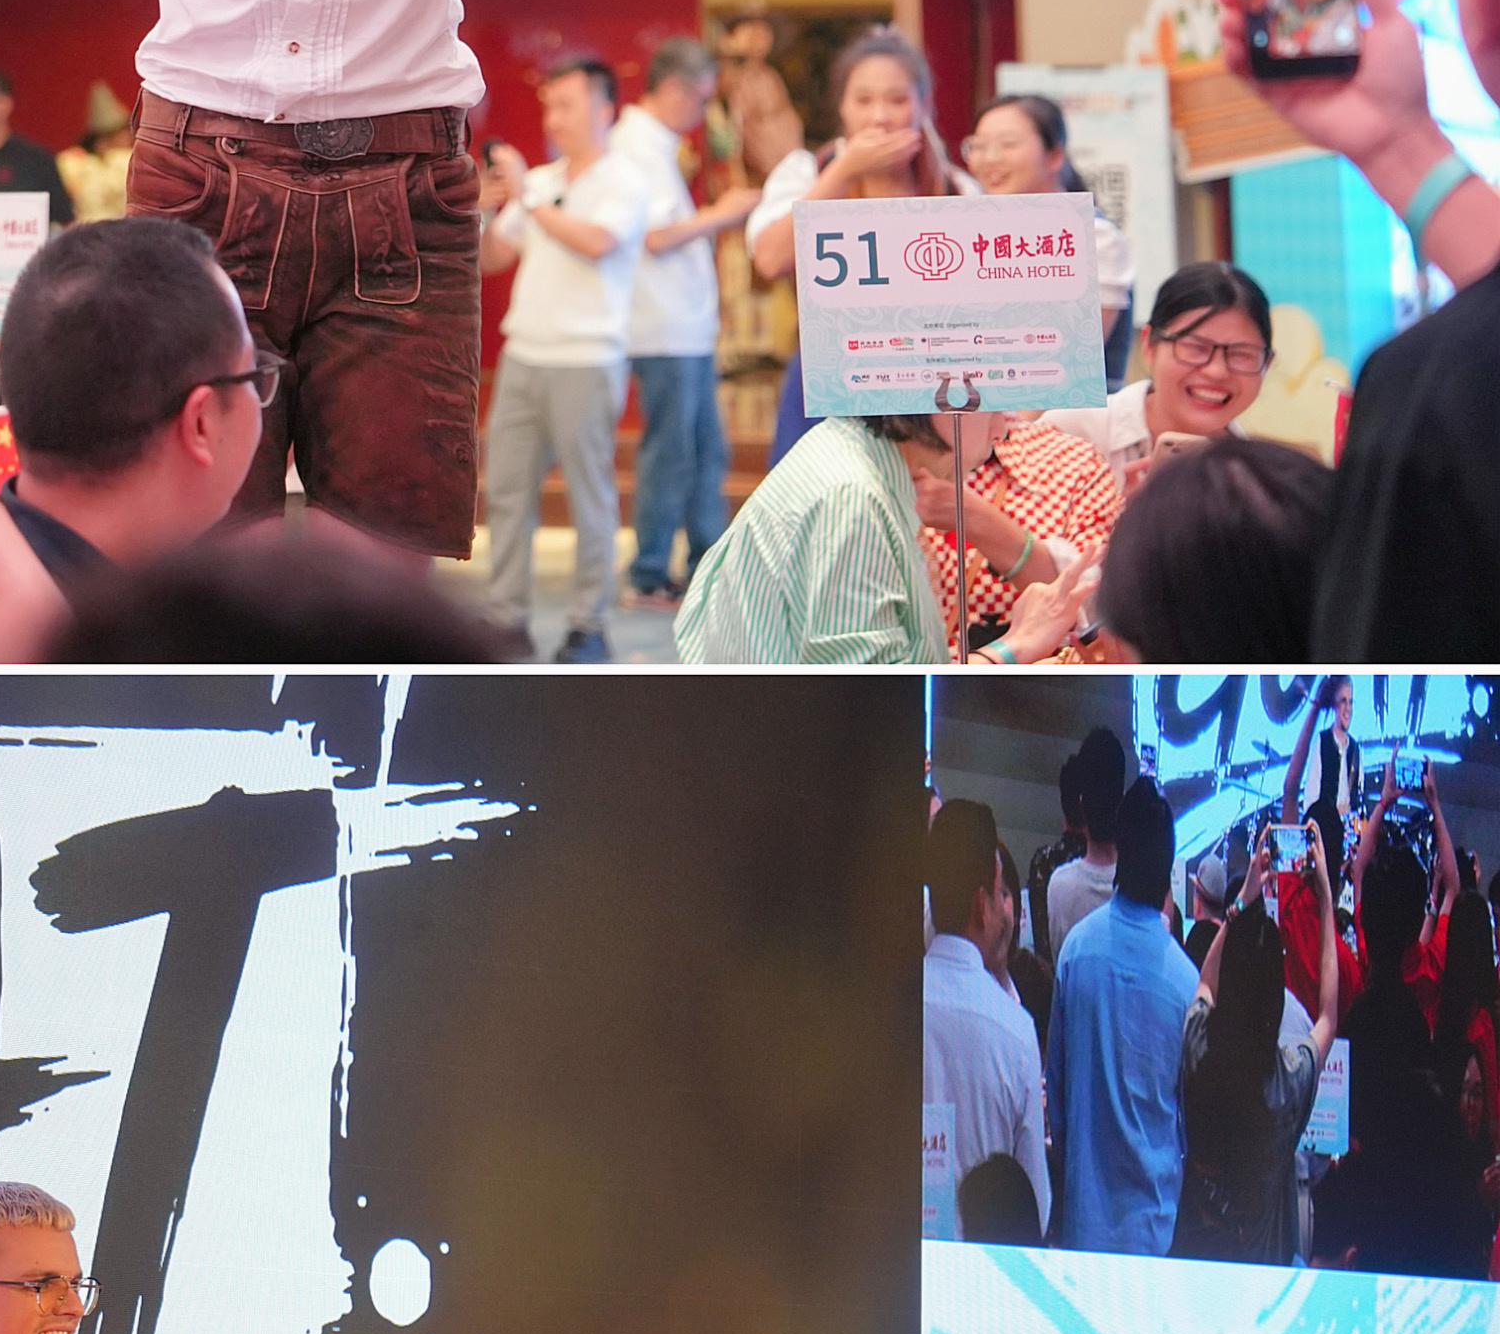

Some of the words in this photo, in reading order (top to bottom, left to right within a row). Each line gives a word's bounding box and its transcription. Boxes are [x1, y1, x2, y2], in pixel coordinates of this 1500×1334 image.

[813, 230, 890, 287] 51
[972, 229, 1076, 267] 中國大酒店
[977, 267, 1023, 280] CHINA
[1028, 265, 1076, 278] HOTEL
